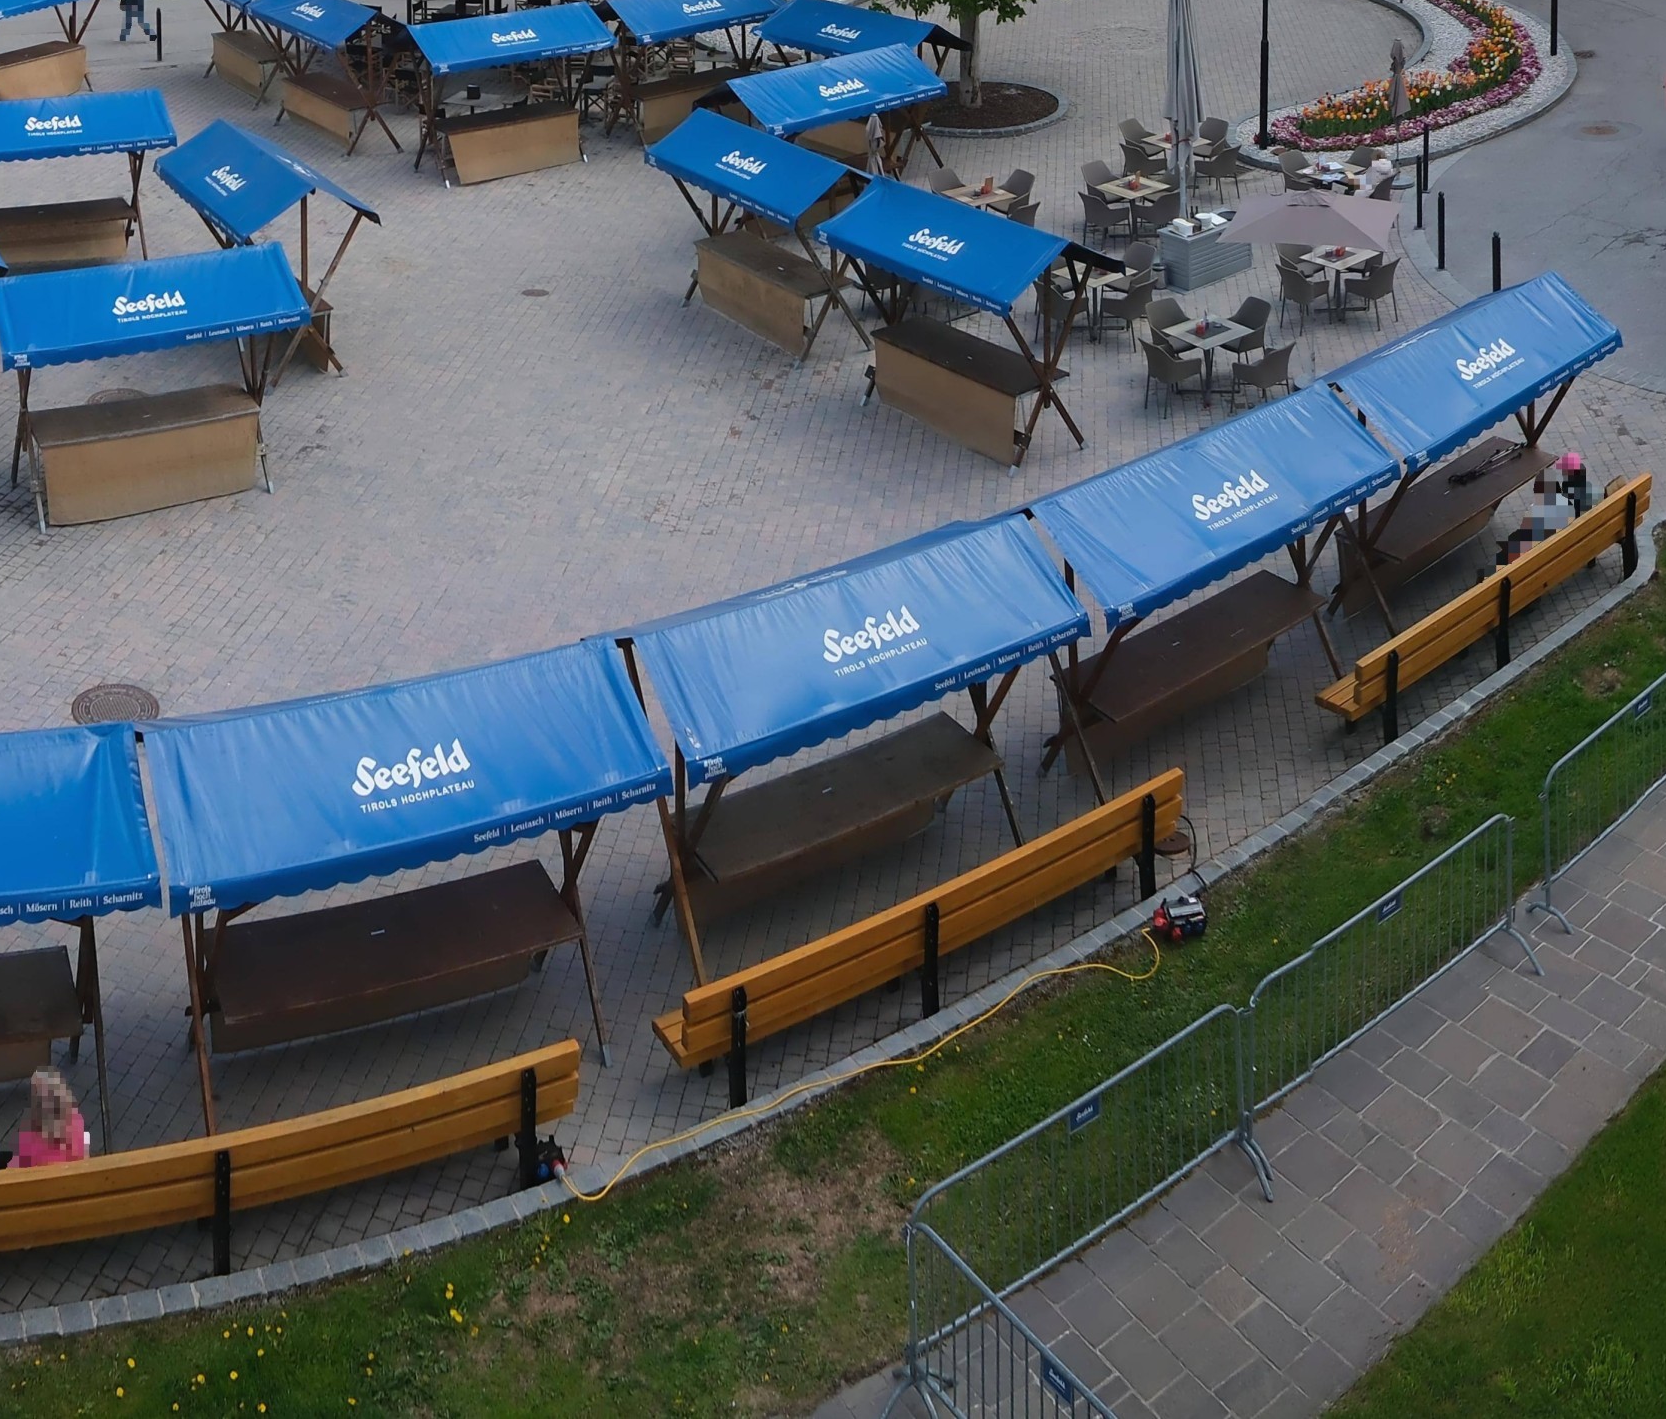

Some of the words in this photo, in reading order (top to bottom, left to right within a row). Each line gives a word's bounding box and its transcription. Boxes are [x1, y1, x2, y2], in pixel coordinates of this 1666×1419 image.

[295, 2, 326, 19] Seefeld
[491, 29, 537, 45] Seefeld
[820, 23, 861, 40] Seefeld
[818, 78, 866, 99] Seefeld
[24, 114, 82, 132] Seefeld
[721, 150, 769, 175] Seefeld
[211, 165, 247, 192] Seefeld
[908, 228, 965, 257] Seefeld
[111, 289, 186, 316] Seefeld
[1455, 337, 1516, 382] Seefeld
[1192, 469, 1270, 521] Seefeld
[1207, 517, 1231, 531] TIROLS
[1231, 492, 1279, 519] HOCHPLATEAU
[822, 604, 921, 663] Seefeld
[833, 660, 866, 678] TIROLS
[867, 637, 928, 665] HOCHPLATEAU
[934, 676, 956, 692] Seefeld
[963, 663, 991, 681] Leutasch
[997, 650, 1021, 666] Mösern
[1027, 639, 1044, 653] Reith
[1050, 626, 1078, 645] Scharnitz
[351, 738, 471, 797] Seefeld
[359, 797, 398, 815] TIROLS
[400, 779, 476, 806] HOCHPLATEAU
[473, 827, 501, 843] Seefeld
[509, 816, 545, 834] Leutasch
[554, 805, 583, 820] Mösern
[592, 794, 612, 809] Reith
[621, 782, 656, 801] Scharnitz
[25, 900, 58, 914] Mösern
[69, 896, 93, 909] Reith
[102, 889, 143, 905] Scharnitz
[189, 897, 216, 909] plateau
